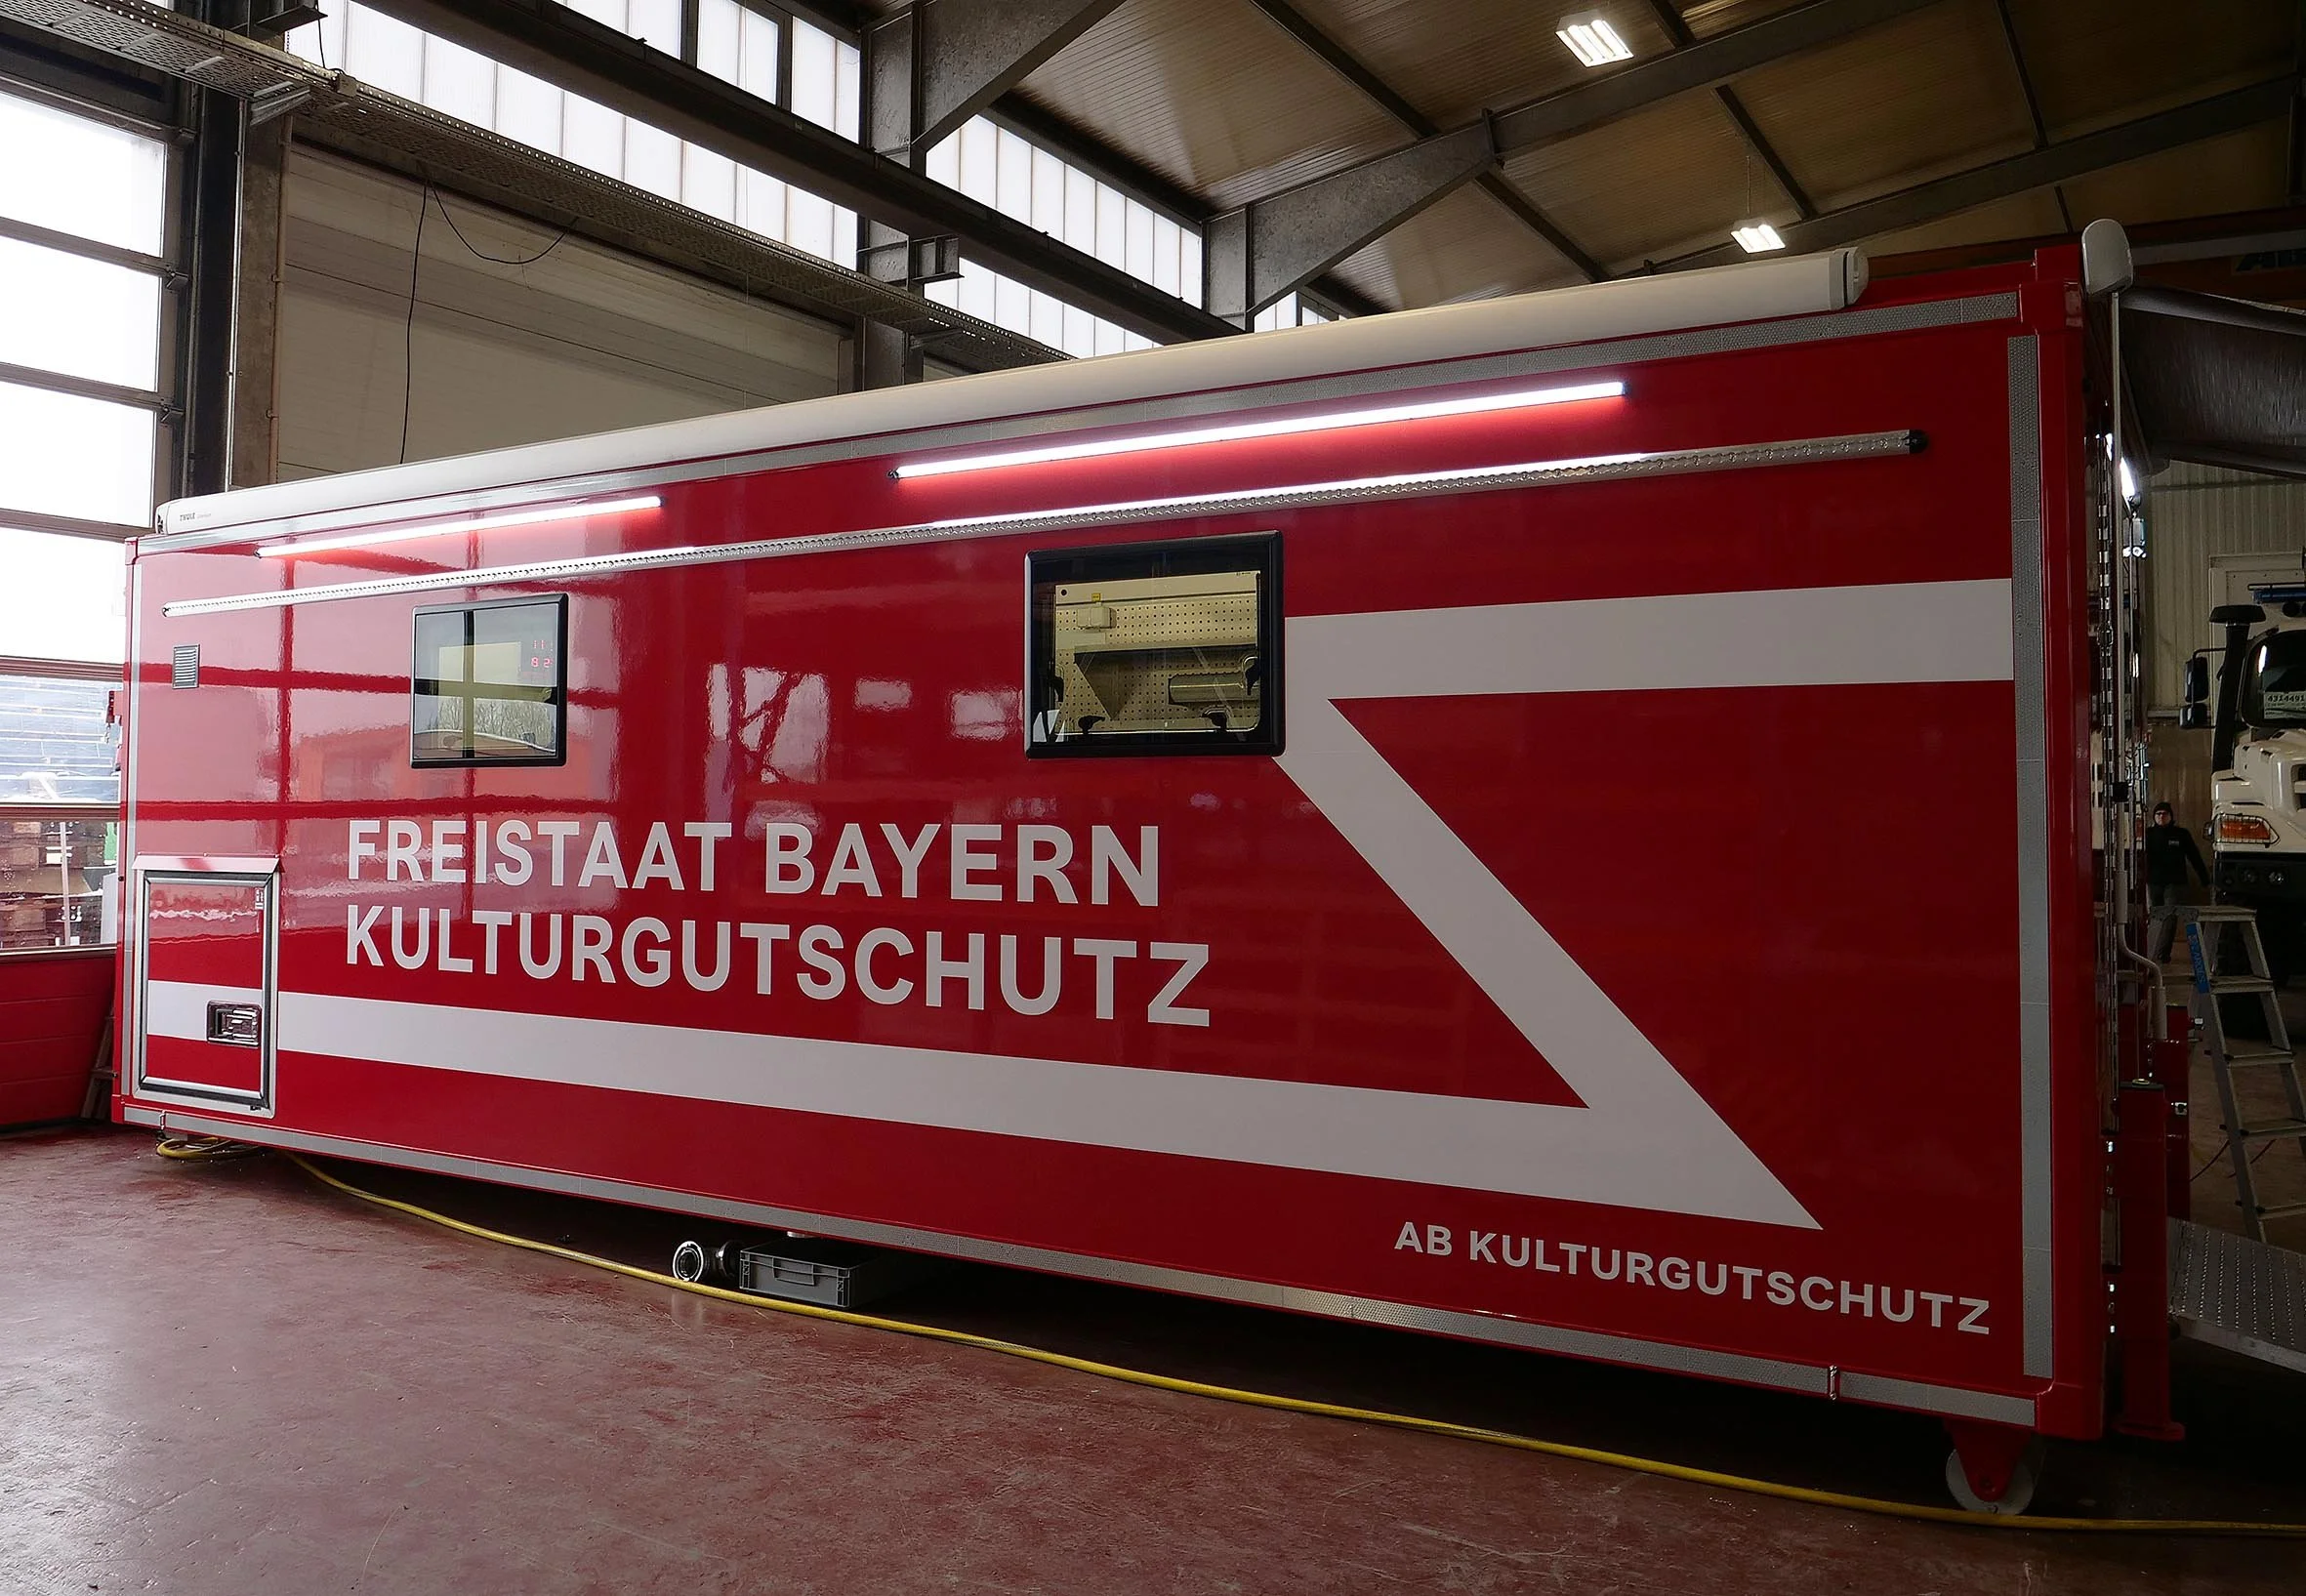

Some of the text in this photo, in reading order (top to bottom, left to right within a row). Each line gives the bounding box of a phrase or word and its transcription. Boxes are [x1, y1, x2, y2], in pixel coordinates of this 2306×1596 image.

[348, 820, 1160, 908] FREISTAAT BAYERN
[346, 902, 1211, 1028] KULTURGUTSCHUTZ
[1394, 1221, 1991, 1336] AB KULTURGUTSCHUTZ
